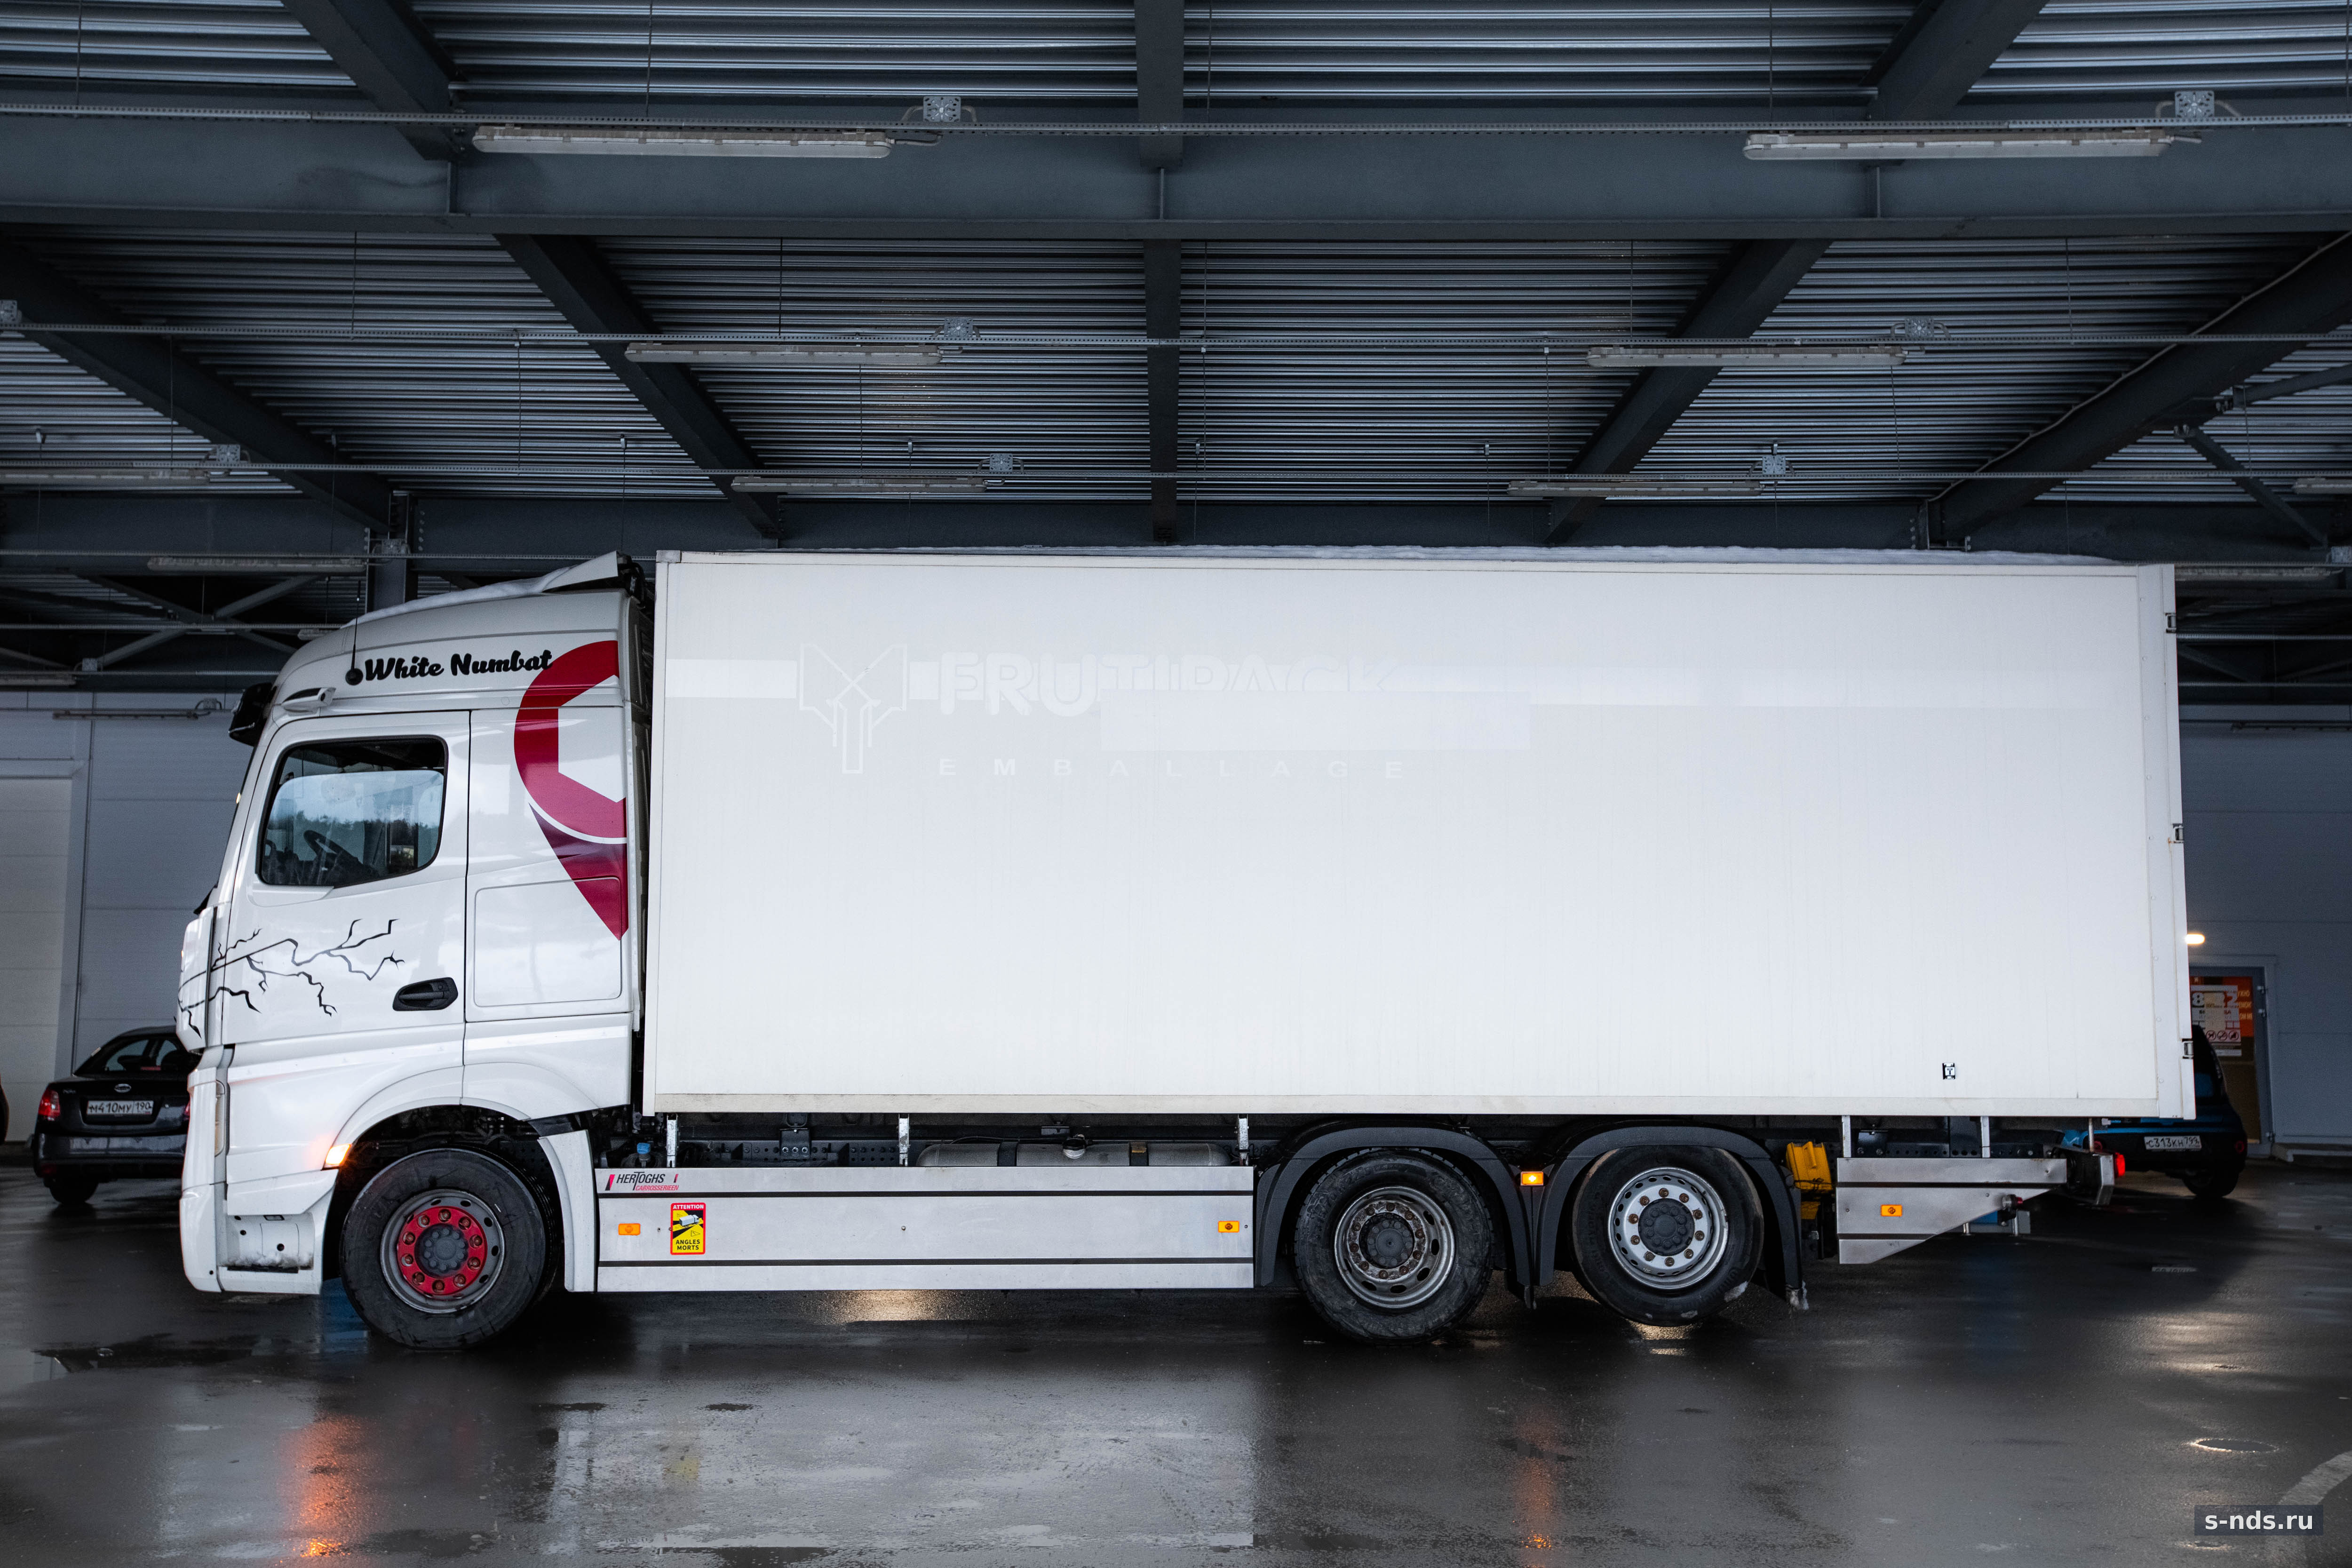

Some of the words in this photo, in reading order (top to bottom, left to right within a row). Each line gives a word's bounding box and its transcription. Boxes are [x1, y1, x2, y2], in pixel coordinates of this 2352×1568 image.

[365, 655, 444, 681] White
[451, 649, 553, 676] Numbat
[940, 758, 1403, 780] EMBALLAGE
[616, 1171, 666, 1191] HERTOGHS
